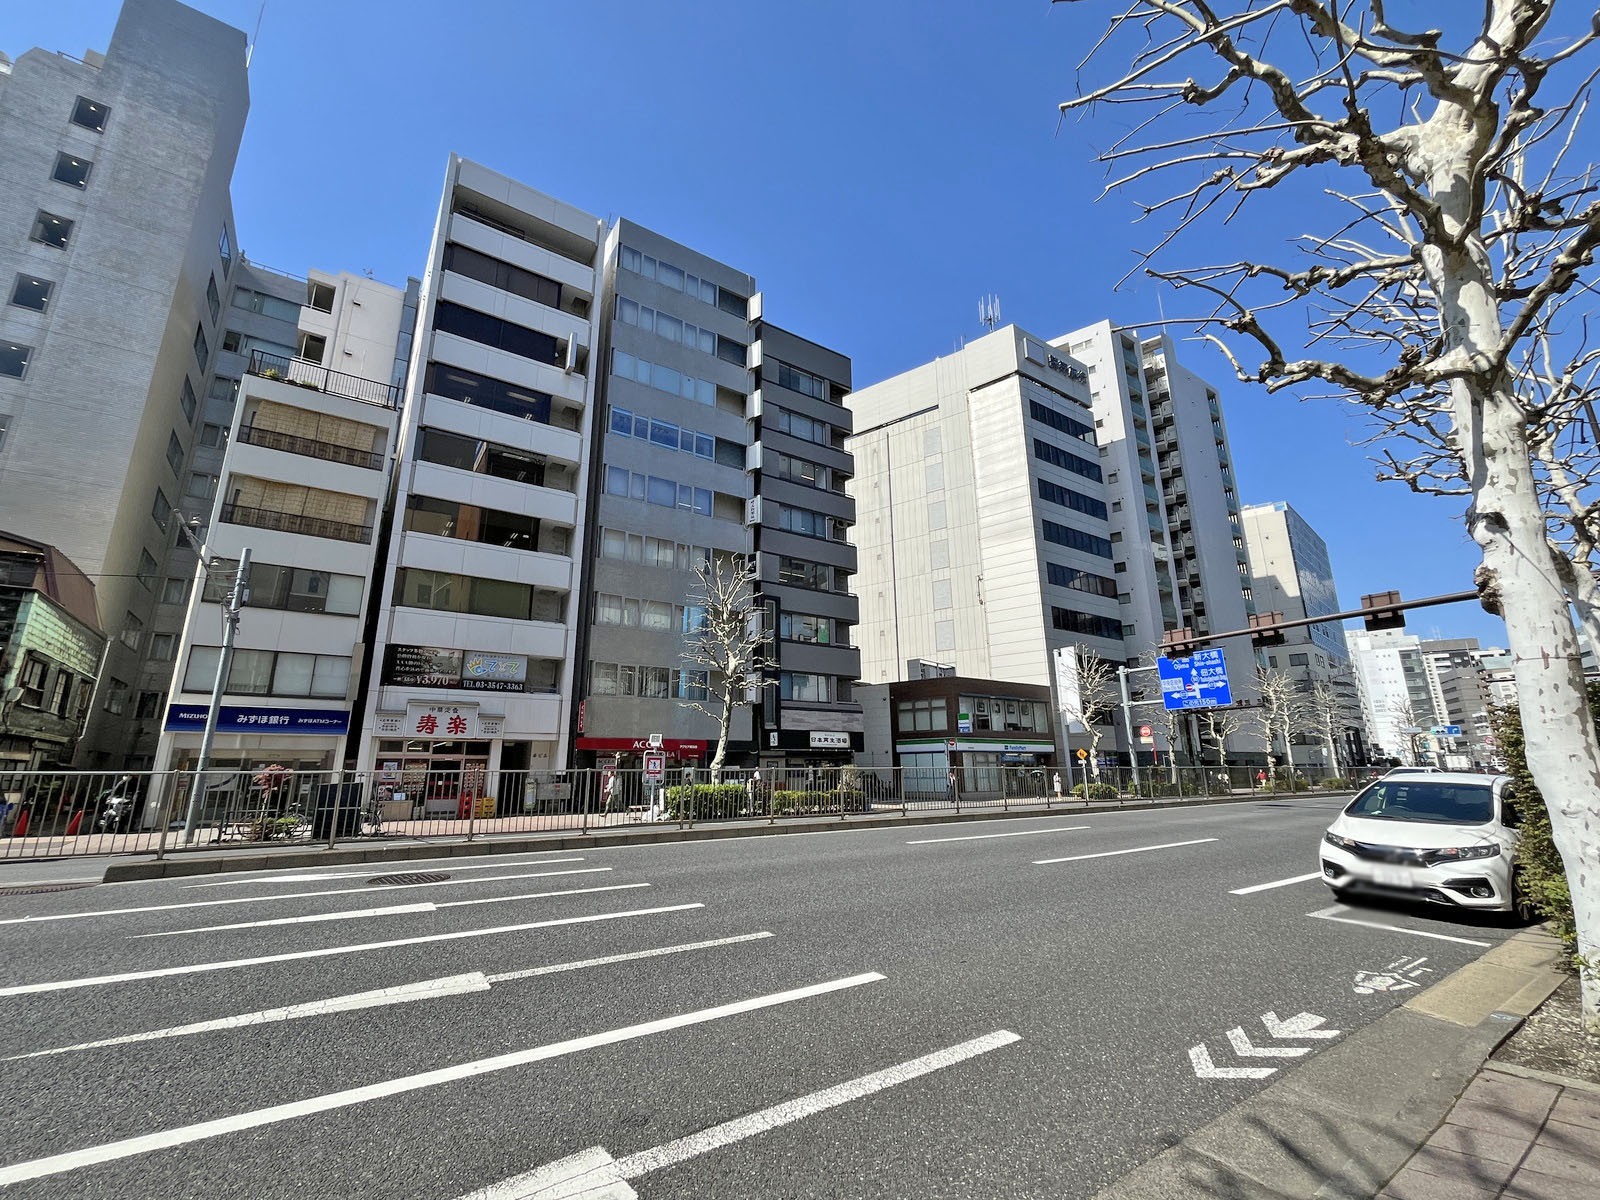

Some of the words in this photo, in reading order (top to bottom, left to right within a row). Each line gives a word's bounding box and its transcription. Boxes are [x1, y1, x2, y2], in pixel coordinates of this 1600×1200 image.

[237, 714, 290, 725] みずほ銀行
[416, 713, 468, 735] 寿楽
